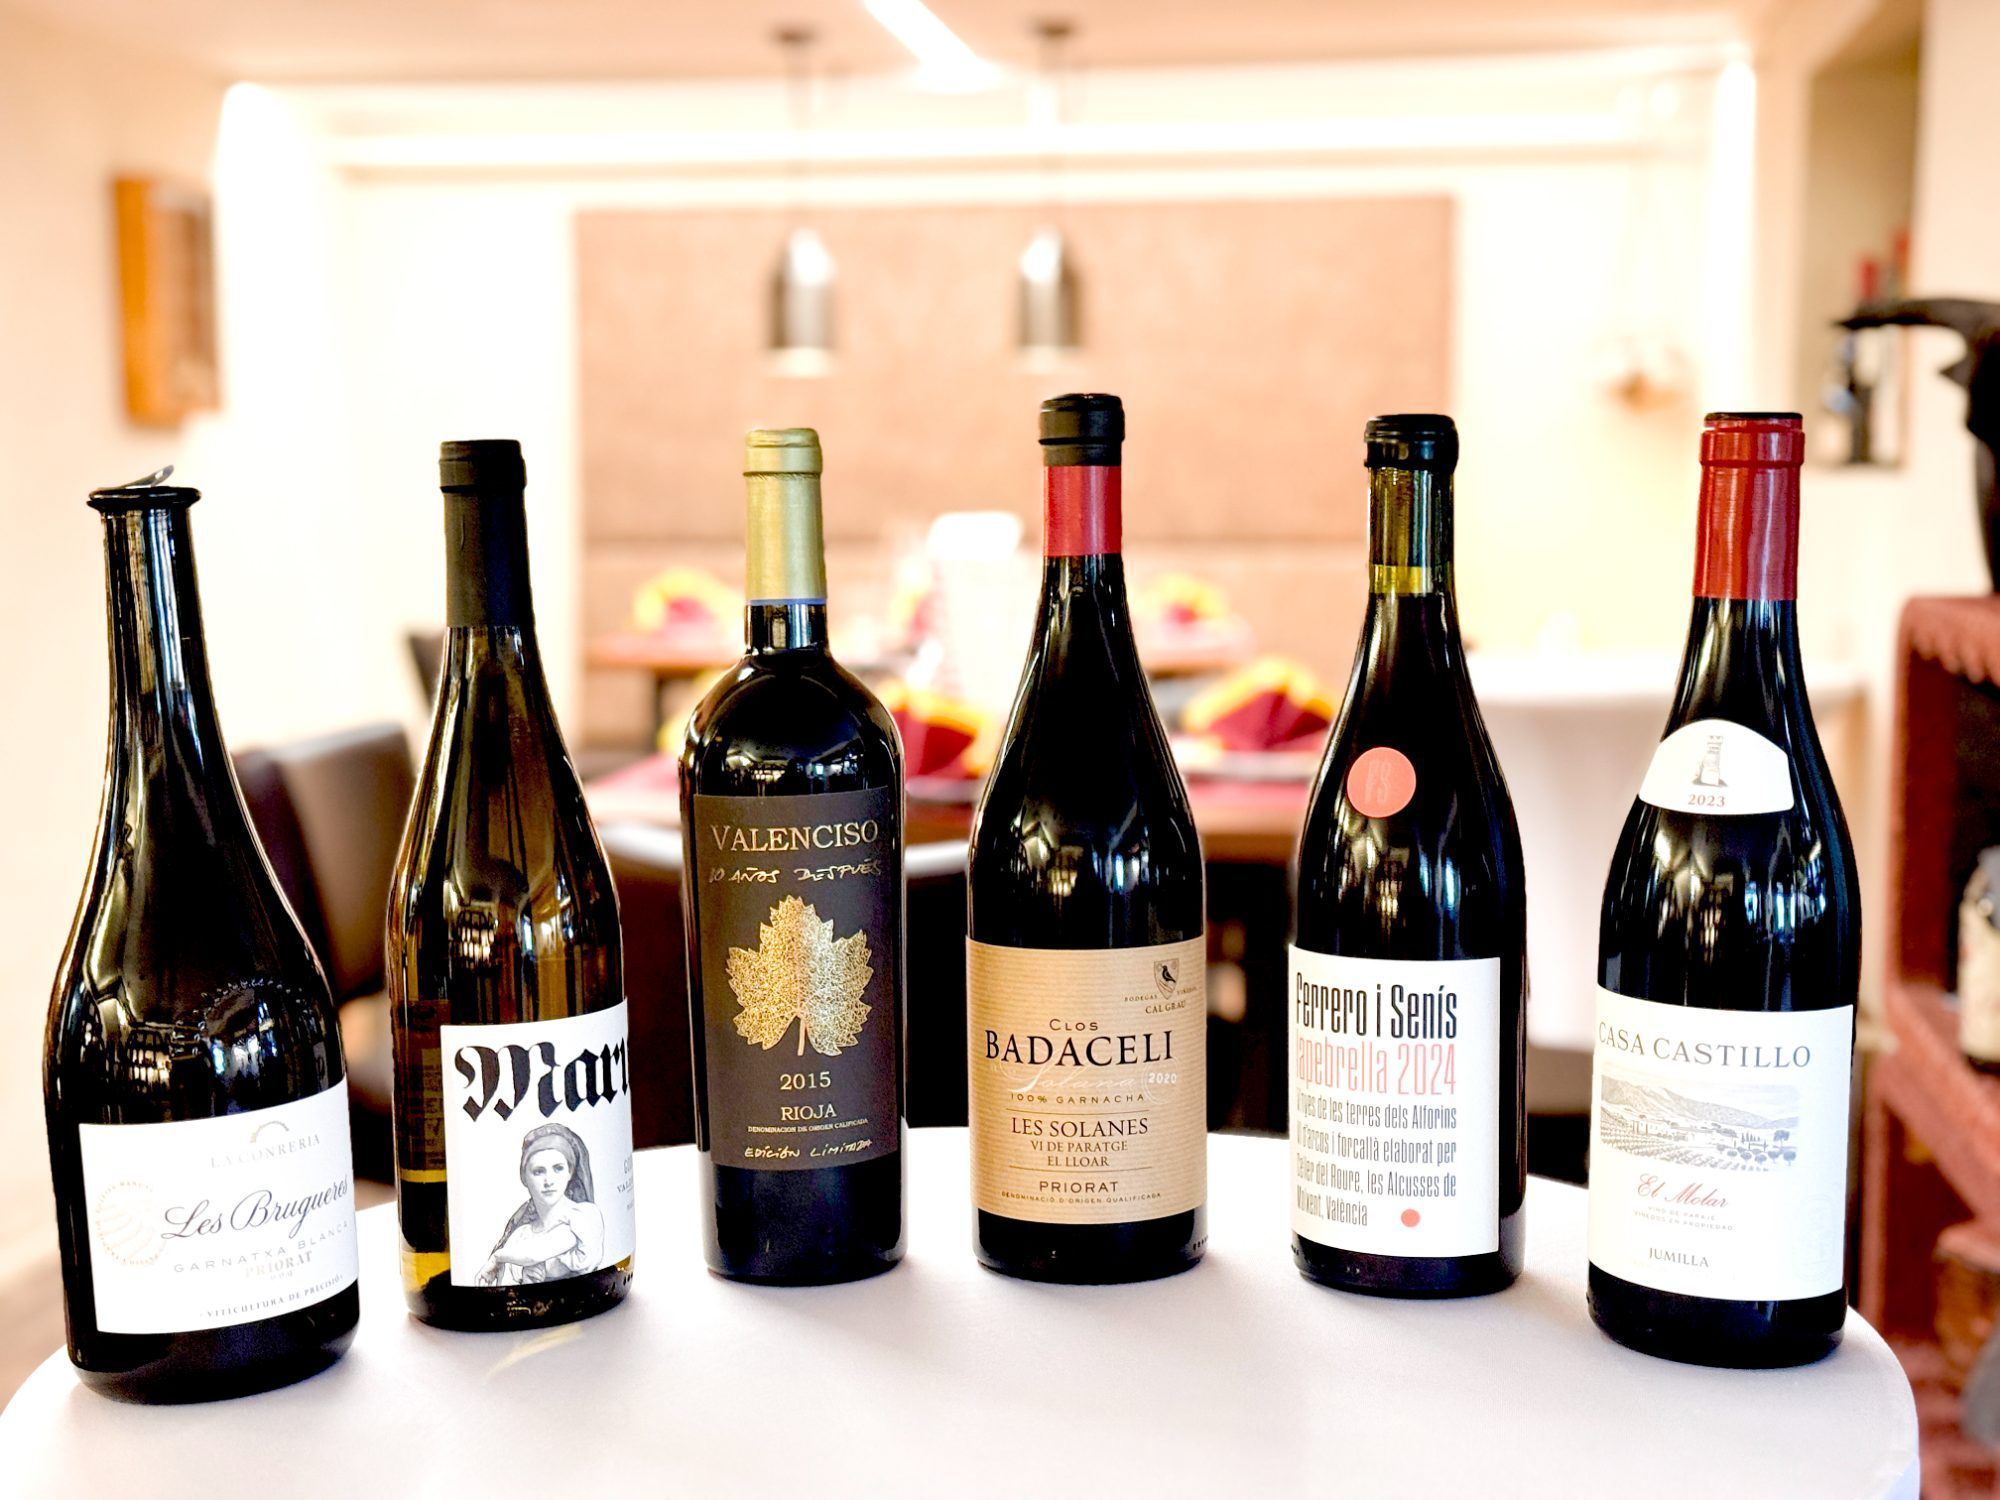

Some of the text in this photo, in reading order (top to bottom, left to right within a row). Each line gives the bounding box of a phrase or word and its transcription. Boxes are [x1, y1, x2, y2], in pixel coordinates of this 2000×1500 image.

[1688, 793, 1726, 807] 2023
[710, 819, 878, 852] VALENCISO
[1296, 971, 1457, 1039] Ferrero i Senís
[984, 1028, 1174, 1068] BADACELI
[1598, 1021, 1811, 1068] CASA CASTILLO
[780, 1071, 831, 1090] 2015
[1147, 1070, 1178, 1085] 2020
[1397, 1043, 1457, 1095] 2024
[781, 1103, 837, 1121] RIOJA
[1011, 1092, 1144, 1105] 100% GARNACHA
[1317, 1095, 1327, 1119] de
[1329, 1097, 1343, 1123] les
[1346, 1100, 1380, 1127] terres
[1384, 1104, 1408, 1129] dels
[1412, 1105, 1457, 1129] Alforins
[1010, 1117, 1149, 1138] LES SOLANES
[209, 1133, 321, 1169] LA CONRERIA
[1030, 1139, 1128, 1153] VI DE PARATGE
[1337, 1132, 1379, 1161] forcallà
[1384, 1138, 1433, 1163] elaborat
[1437, 1142, 1457, 1167] per
[1047, 1155, 1110, 1167] EL LLOAR
[1039, 1180, 1119, 1193] PRIORAT
[1316, 1161, 1328, 1187] del
[1330, 1163, 1364, 1194] Roure,
[1367, 1169, 1383, 1195] les
[1387, 1171, 1440, 1197] Alcusses
[1443, 1172, 1456, 1197] de
[1637, 1172, 1729, 1208] El Molar
[160, 1199, 223, 1240] Les
[230, 1174, 349, 1240] Brugueres
[1325, 1195, 1368, 1226] València
[174, 1246, 286, 1273] GARNATXA
[246, 1251, 312, 1278] PRIORAT
[1649, 1247, 1709, 1268] JUMILLA
[207, 1296, 284, 1317] VITICULTURA
